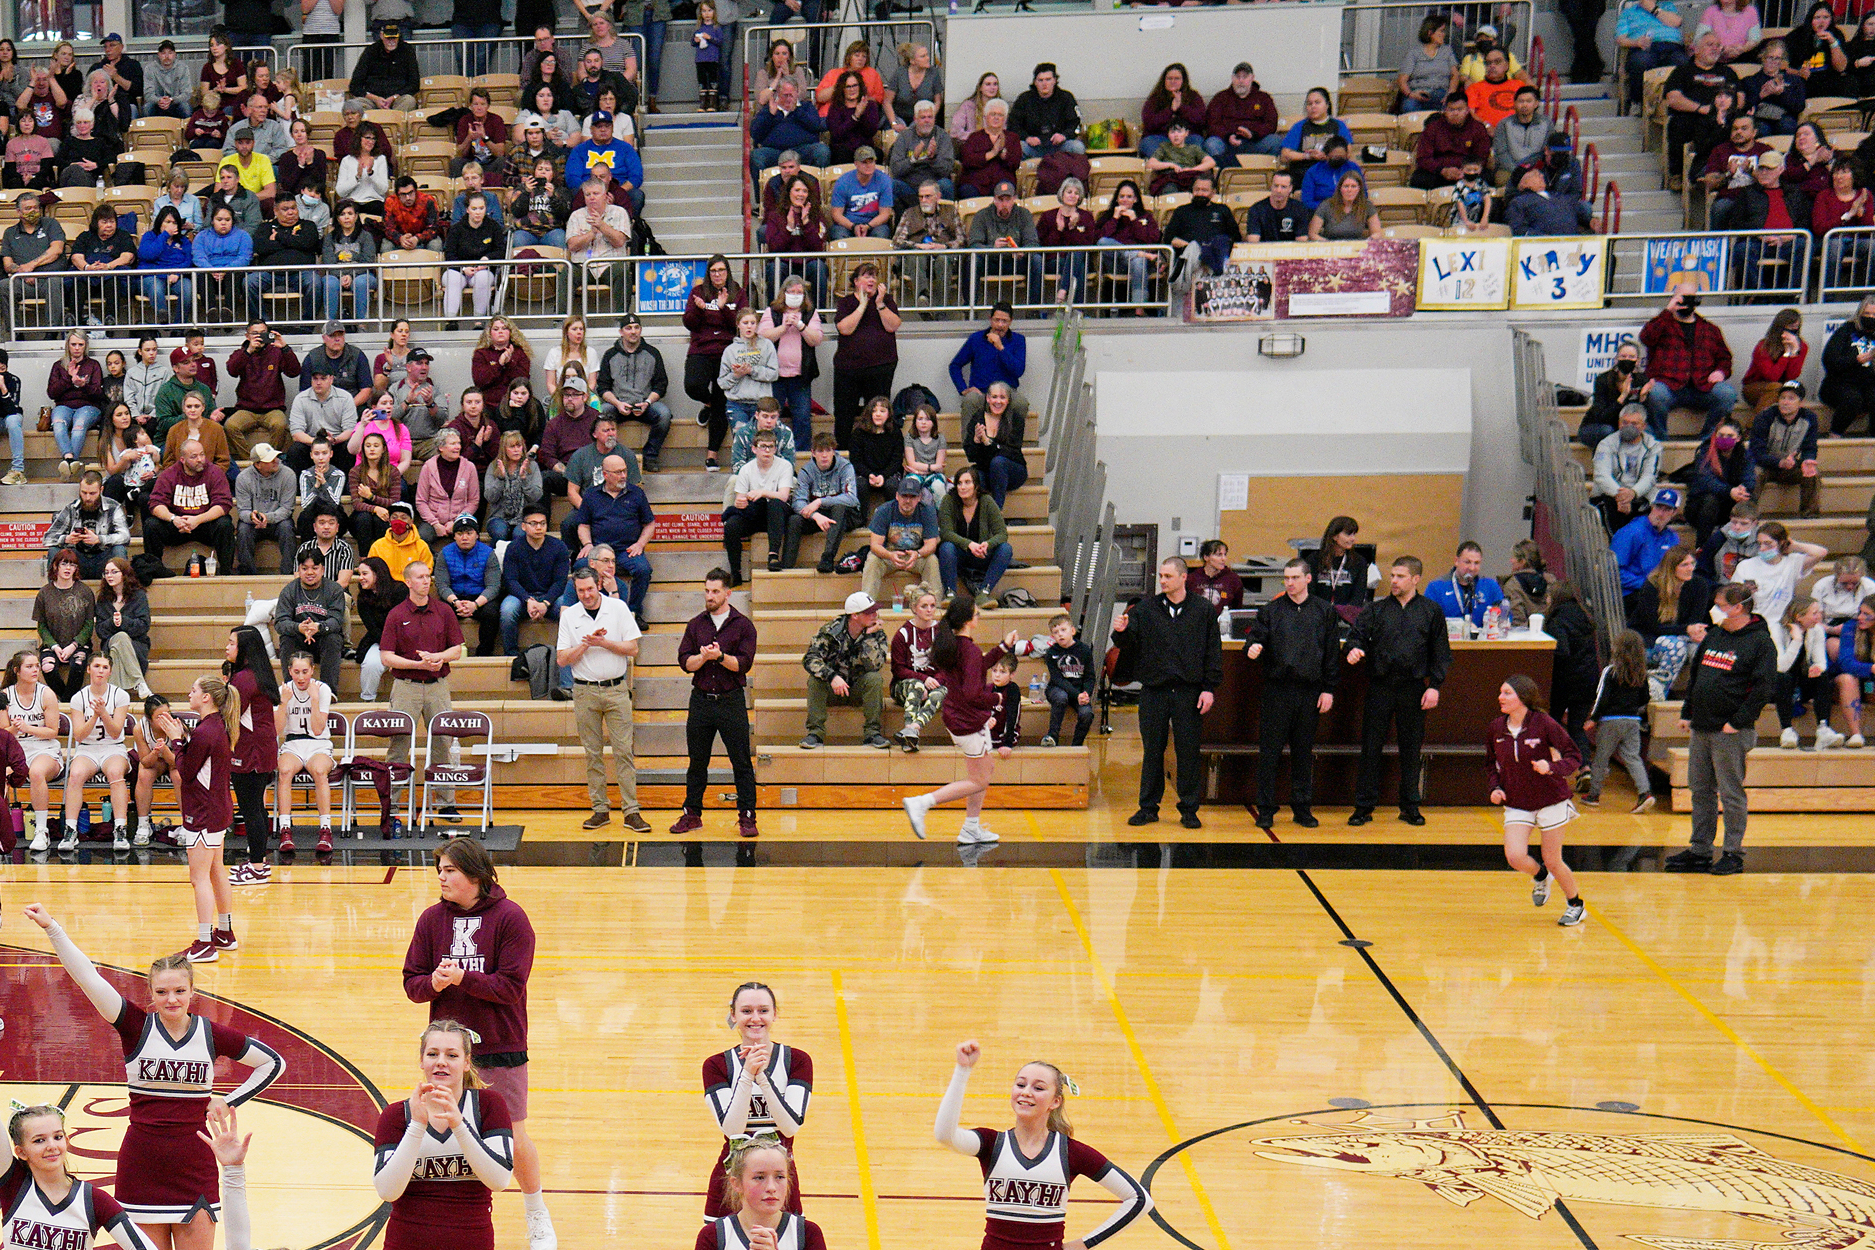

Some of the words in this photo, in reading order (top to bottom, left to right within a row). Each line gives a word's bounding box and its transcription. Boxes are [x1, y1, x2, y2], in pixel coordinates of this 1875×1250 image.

[586, 150, 616, 169] M
[1650, 240, 1680, 259] WEAR
[1690, 239, 1721, 257] MASK
[1433, 250, 1485, 281] LEXI
[1455, 279, 1476, 300] 12
[1551, 277, 1567, 300] 3
[640, 300, 657, 312] WASH
[658, 299, 675, 311] THEM
[27, 713, 45, 721] KINGS
[299, 717, 309, 735] 4
[363, 718, 404, 727] KAYHI
[440, 718, 481, 728] KAYHI
[96, 725, 106, 742] 3
[434, 773, 468, 781] KINGS
[450, 916, 482, 957] K
[138, 1057, 211, 1086] KAYHI
[988, 1178, 1067, 1207] KAYHI
